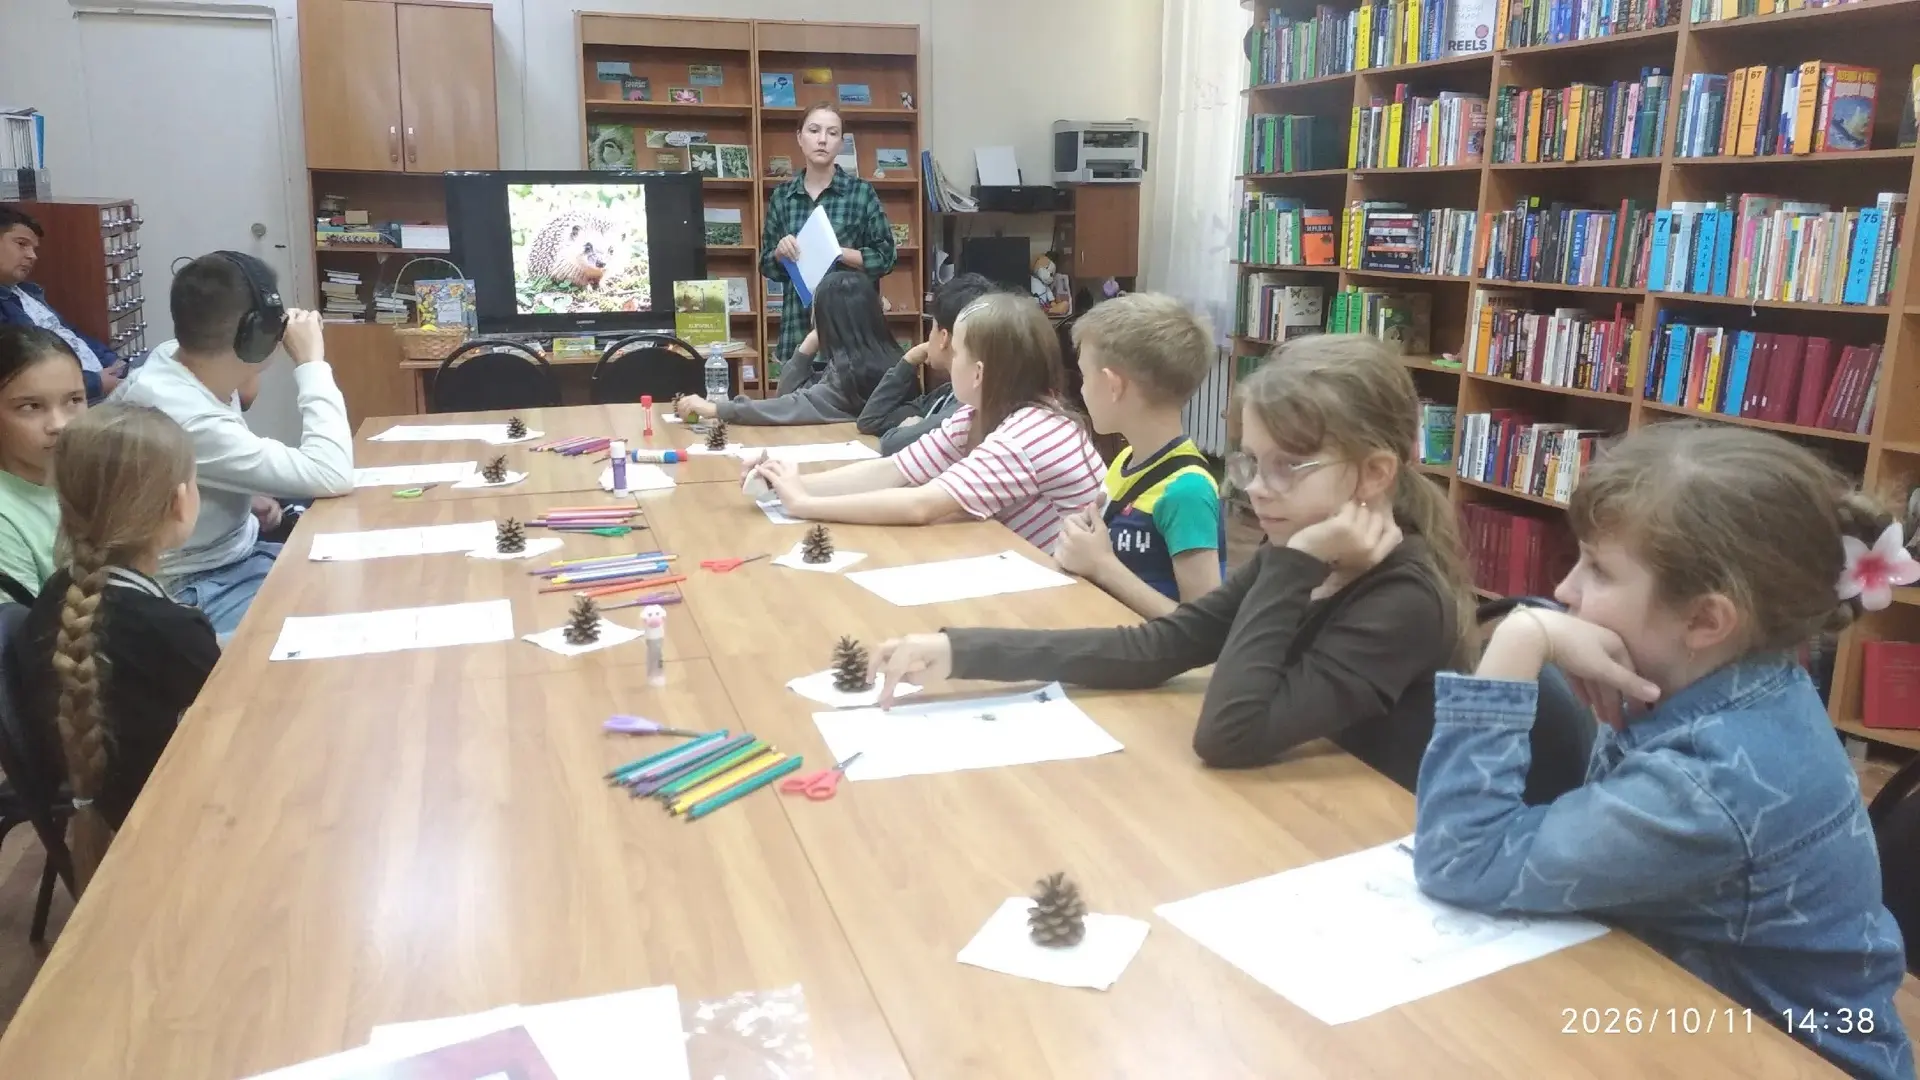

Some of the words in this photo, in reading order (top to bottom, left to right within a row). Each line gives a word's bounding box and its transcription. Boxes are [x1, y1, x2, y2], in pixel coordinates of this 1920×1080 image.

[1447, 40, 1487, 51] REELS
[1750, 71, 1762, 80] 67
[1805, 66, 1815, 75] 68
[1705, 212, 1716, 222] 72
[1863, 213, 1879, 224] 75
[1657, 217, 1668, 233] 7
[1857, 239, 1869, 284] СПОРТ
[1108, 528, 1151, 553] AY
